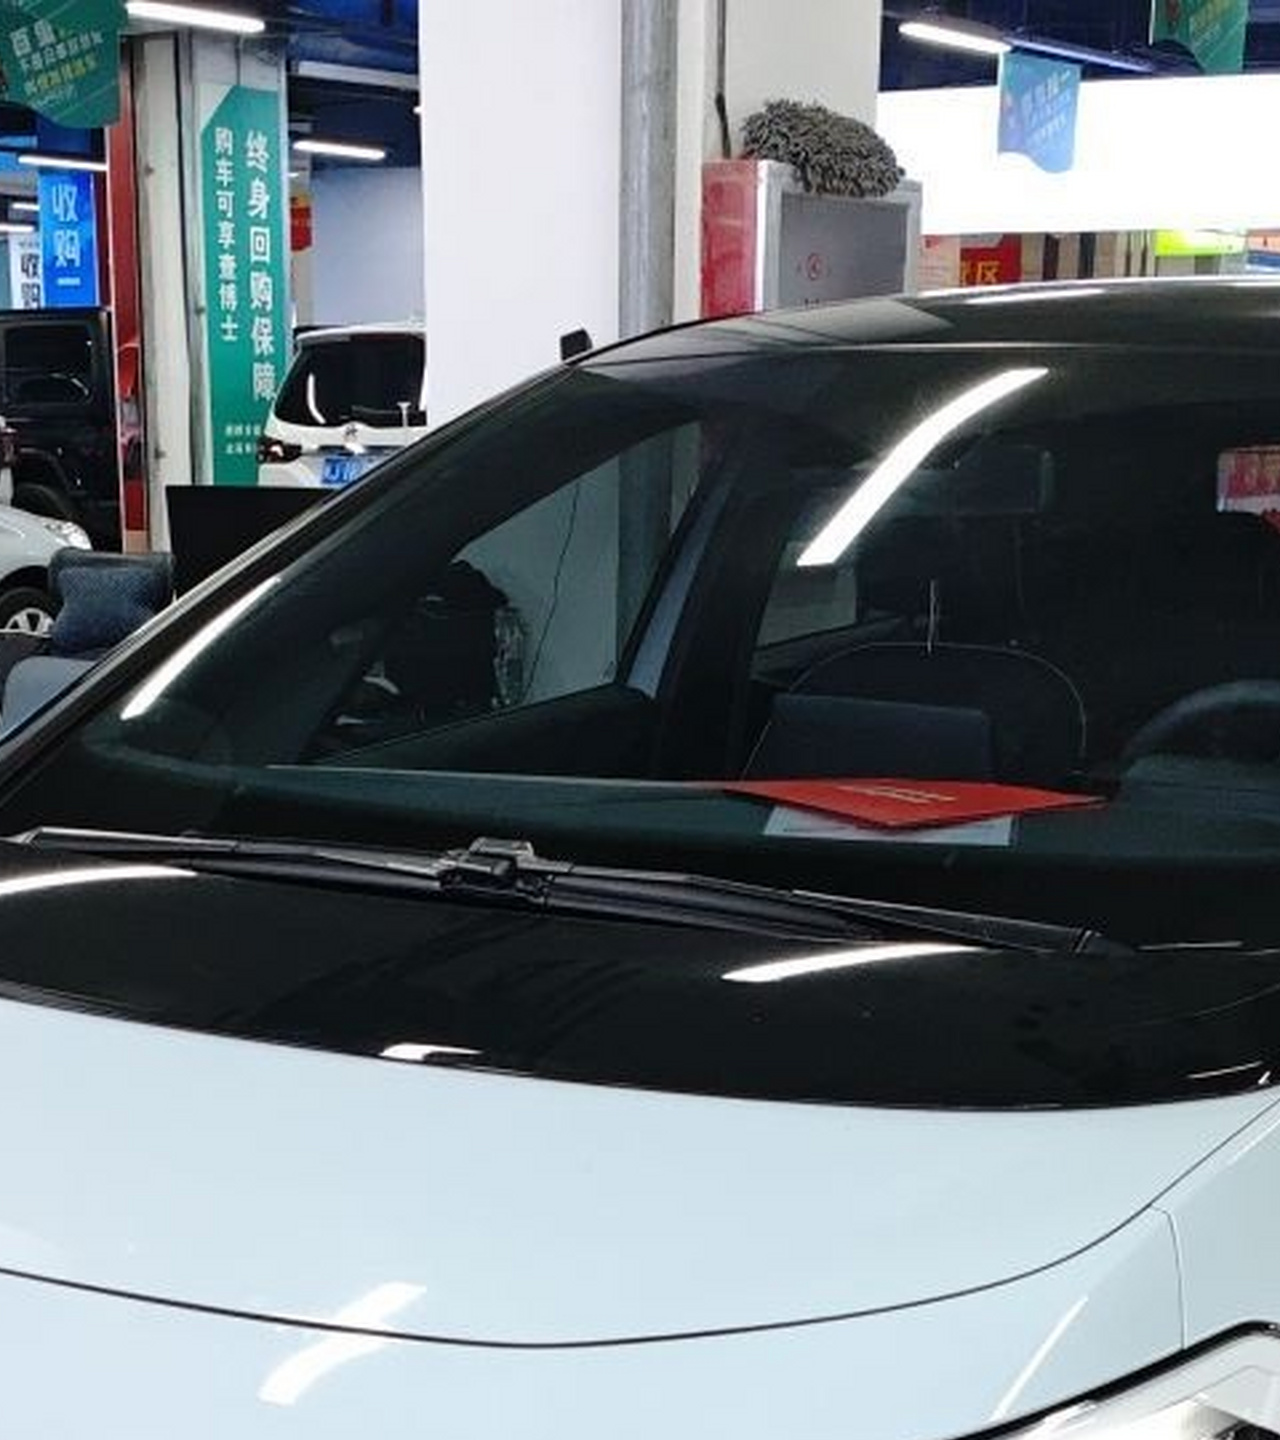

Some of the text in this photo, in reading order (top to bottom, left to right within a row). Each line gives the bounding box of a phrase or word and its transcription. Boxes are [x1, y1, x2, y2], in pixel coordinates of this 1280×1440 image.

[245, 129, 277, 400] 终身回购保障
